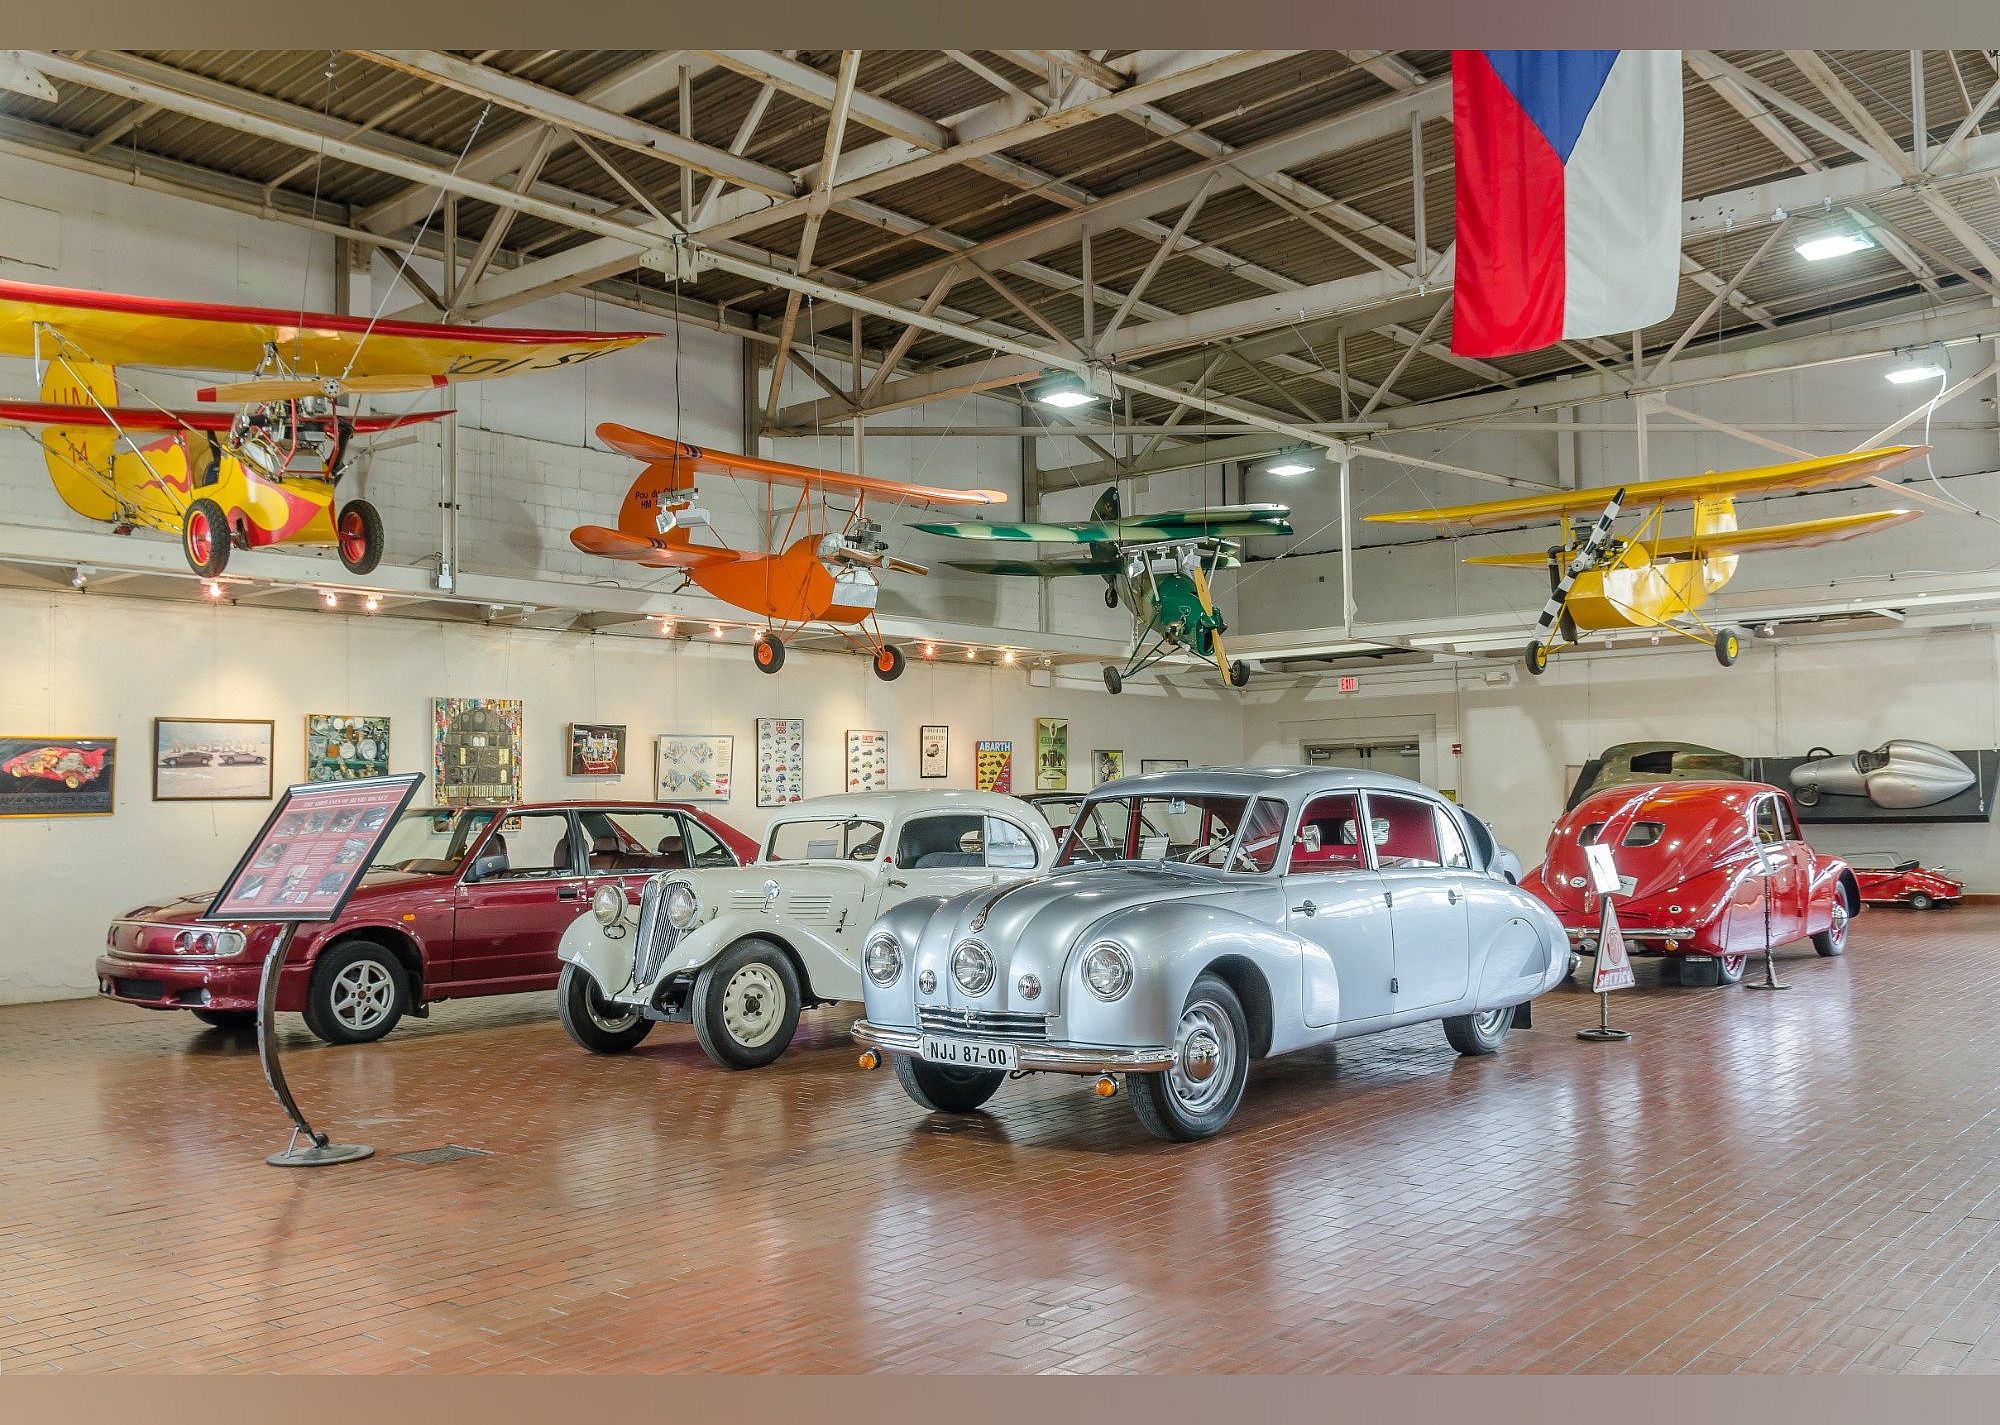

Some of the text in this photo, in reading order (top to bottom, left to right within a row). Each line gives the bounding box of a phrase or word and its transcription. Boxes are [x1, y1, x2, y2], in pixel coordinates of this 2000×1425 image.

[1341, 678, 1355, 690] EXIT
[979, 741, 1011, 752] ABARTH
[930, 1041, 1008, 1066] NJJ 87-00
